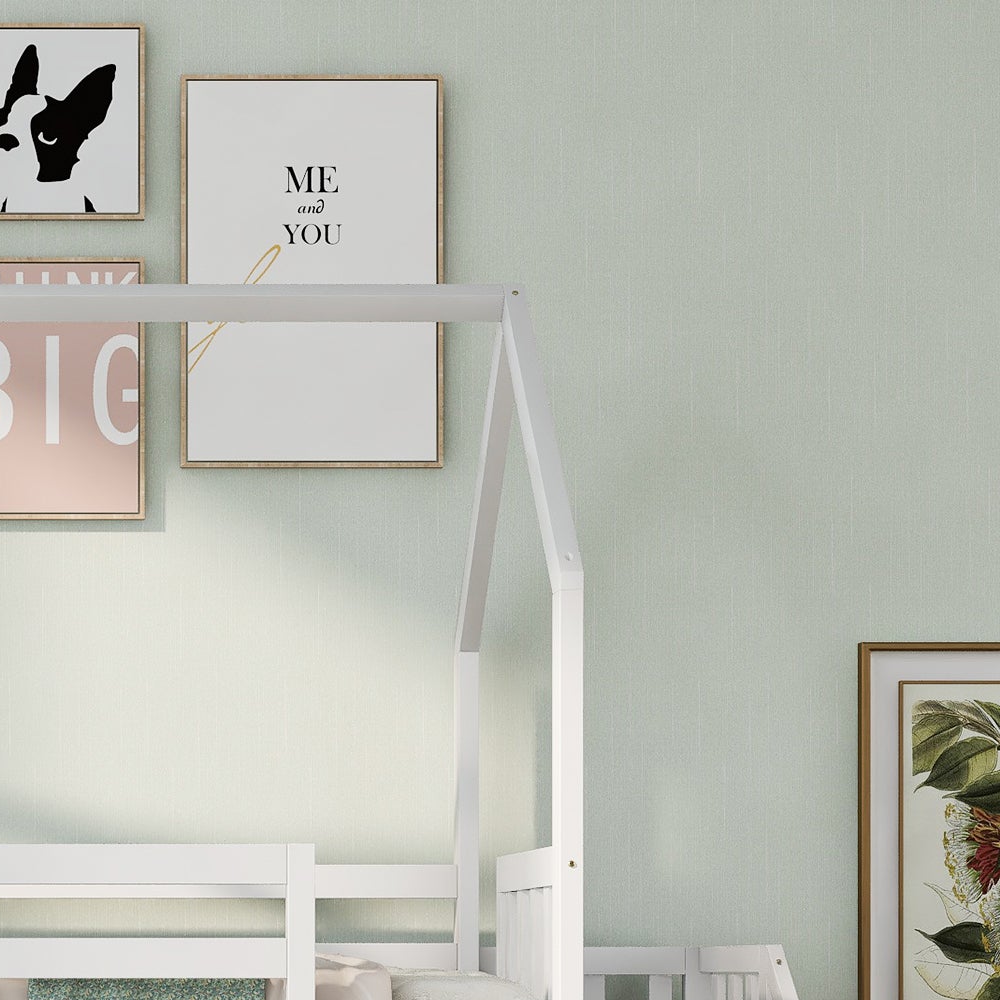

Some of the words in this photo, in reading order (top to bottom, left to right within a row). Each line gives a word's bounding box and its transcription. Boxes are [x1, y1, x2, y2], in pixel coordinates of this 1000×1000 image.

[283, 166, 339, 194] ME
[297, 198, 325, 214] and
[282, 223, 342, 246] YOU
